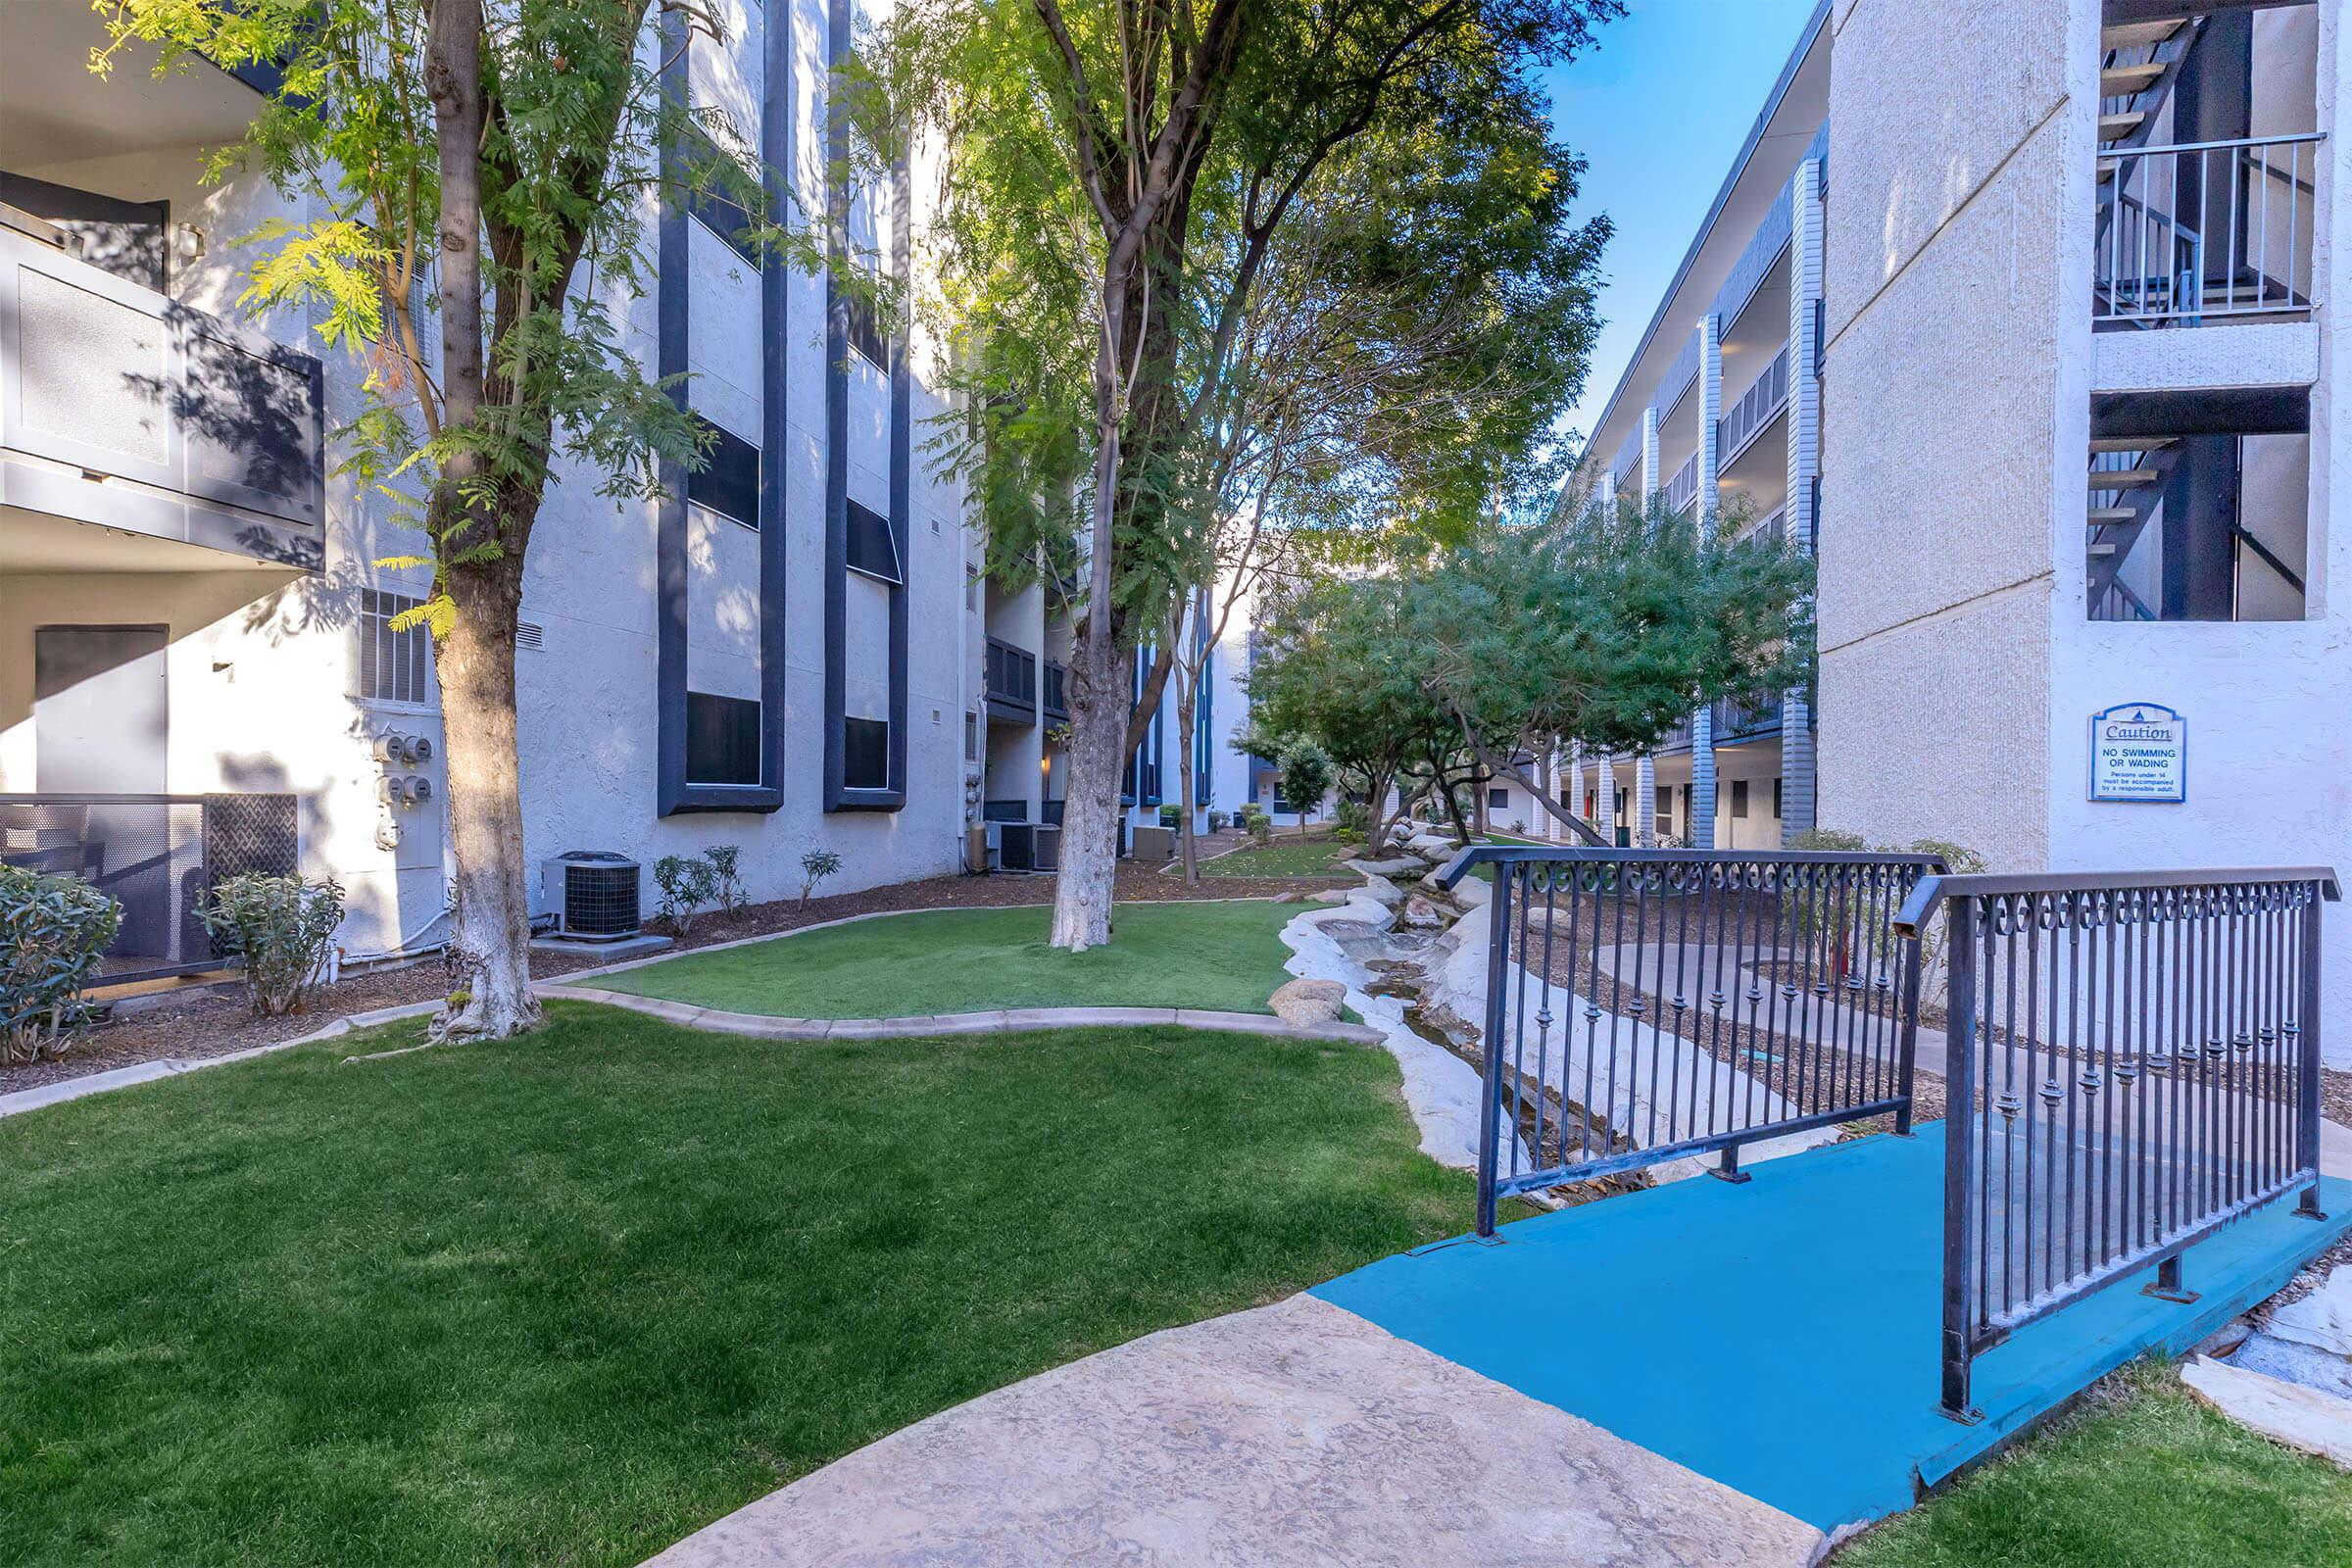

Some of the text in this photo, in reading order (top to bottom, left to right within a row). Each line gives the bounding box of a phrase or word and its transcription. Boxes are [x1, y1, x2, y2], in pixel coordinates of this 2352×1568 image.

[2106, 725, 2172, 739] Caution
[2103, 748, 2176, 759] NO SWIMMING
[2109, 759, 2169, 768] OR WADING
